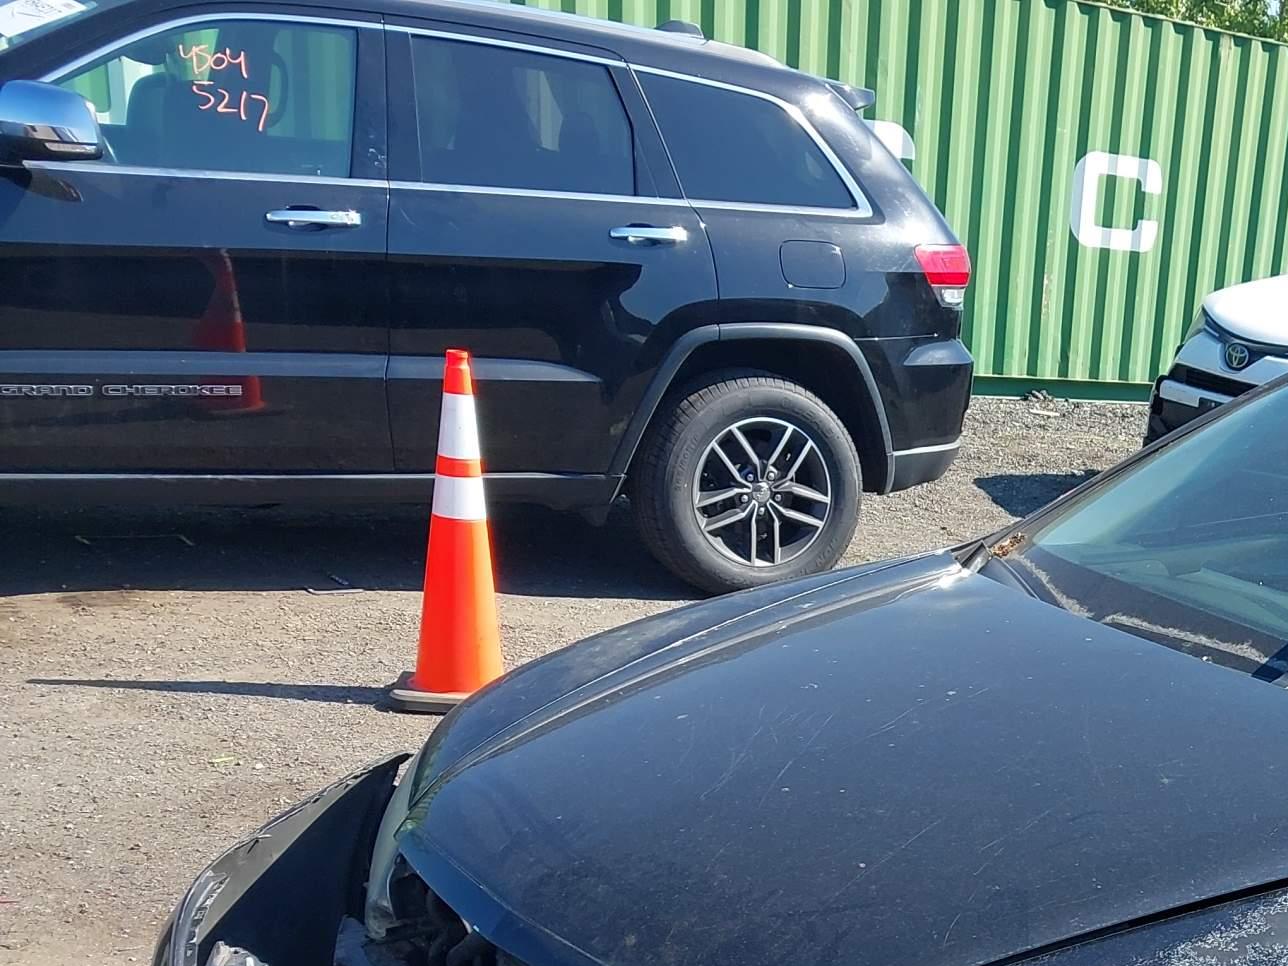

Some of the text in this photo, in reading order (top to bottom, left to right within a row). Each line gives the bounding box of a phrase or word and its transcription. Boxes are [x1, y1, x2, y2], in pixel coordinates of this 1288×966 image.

[178, 44, 248, 79] 4504
[192, 80, 269, 132] 5217
[0, 384, 243, 396] GRAND CHEROKEE
